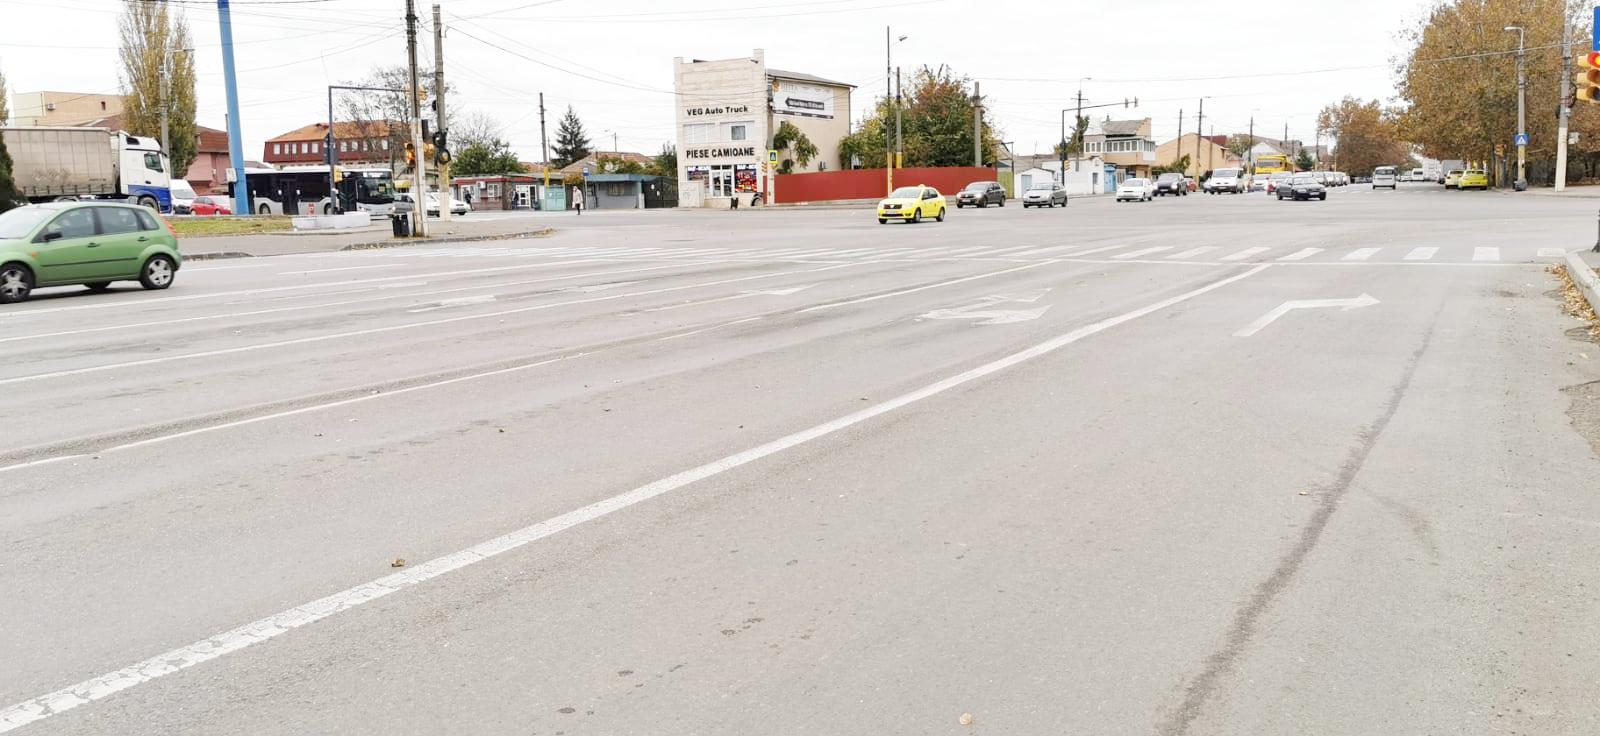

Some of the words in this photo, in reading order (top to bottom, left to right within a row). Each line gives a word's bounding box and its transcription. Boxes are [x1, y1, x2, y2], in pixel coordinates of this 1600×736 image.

[687, 108, 703, 116] VEG
[705, 107, 723, 115] Auto
[725, 105, 748, 114] Truck
[686, 149, 709, 159] PIESE
[711, 147, 755, 158] CAMIOANE
